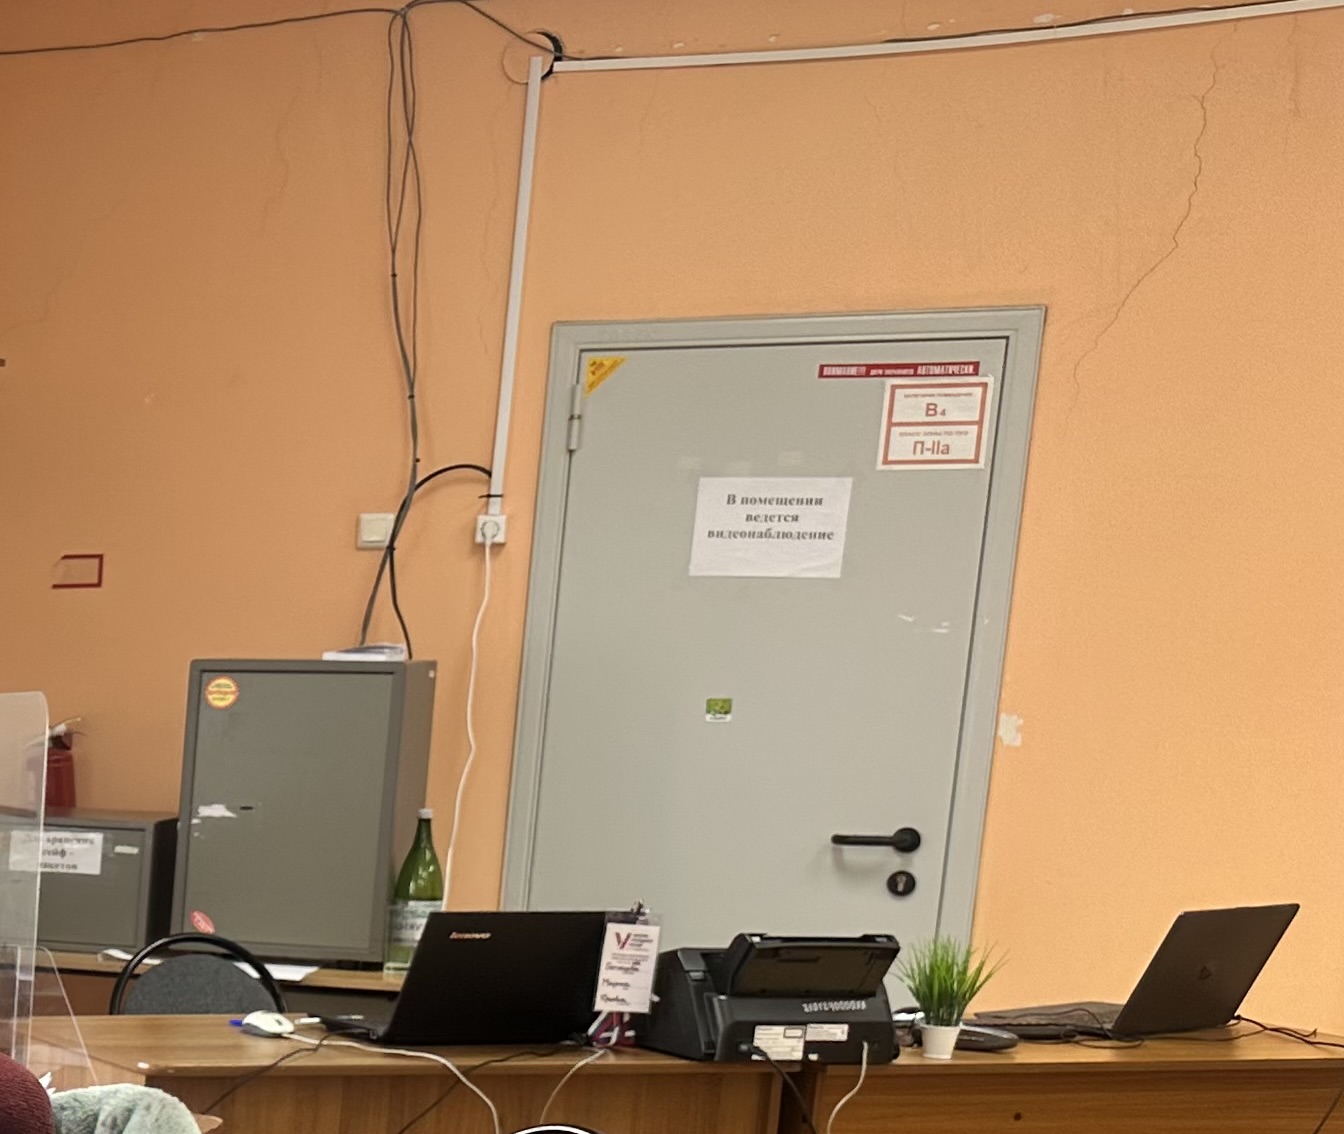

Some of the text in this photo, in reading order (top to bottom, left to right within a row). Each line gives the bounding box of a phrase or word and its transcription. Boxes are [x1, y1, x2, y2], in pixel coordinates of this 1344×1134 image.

[726, 493, 823, 508] В помещении
[707, 528, 834, 540] видеонаблюдение
